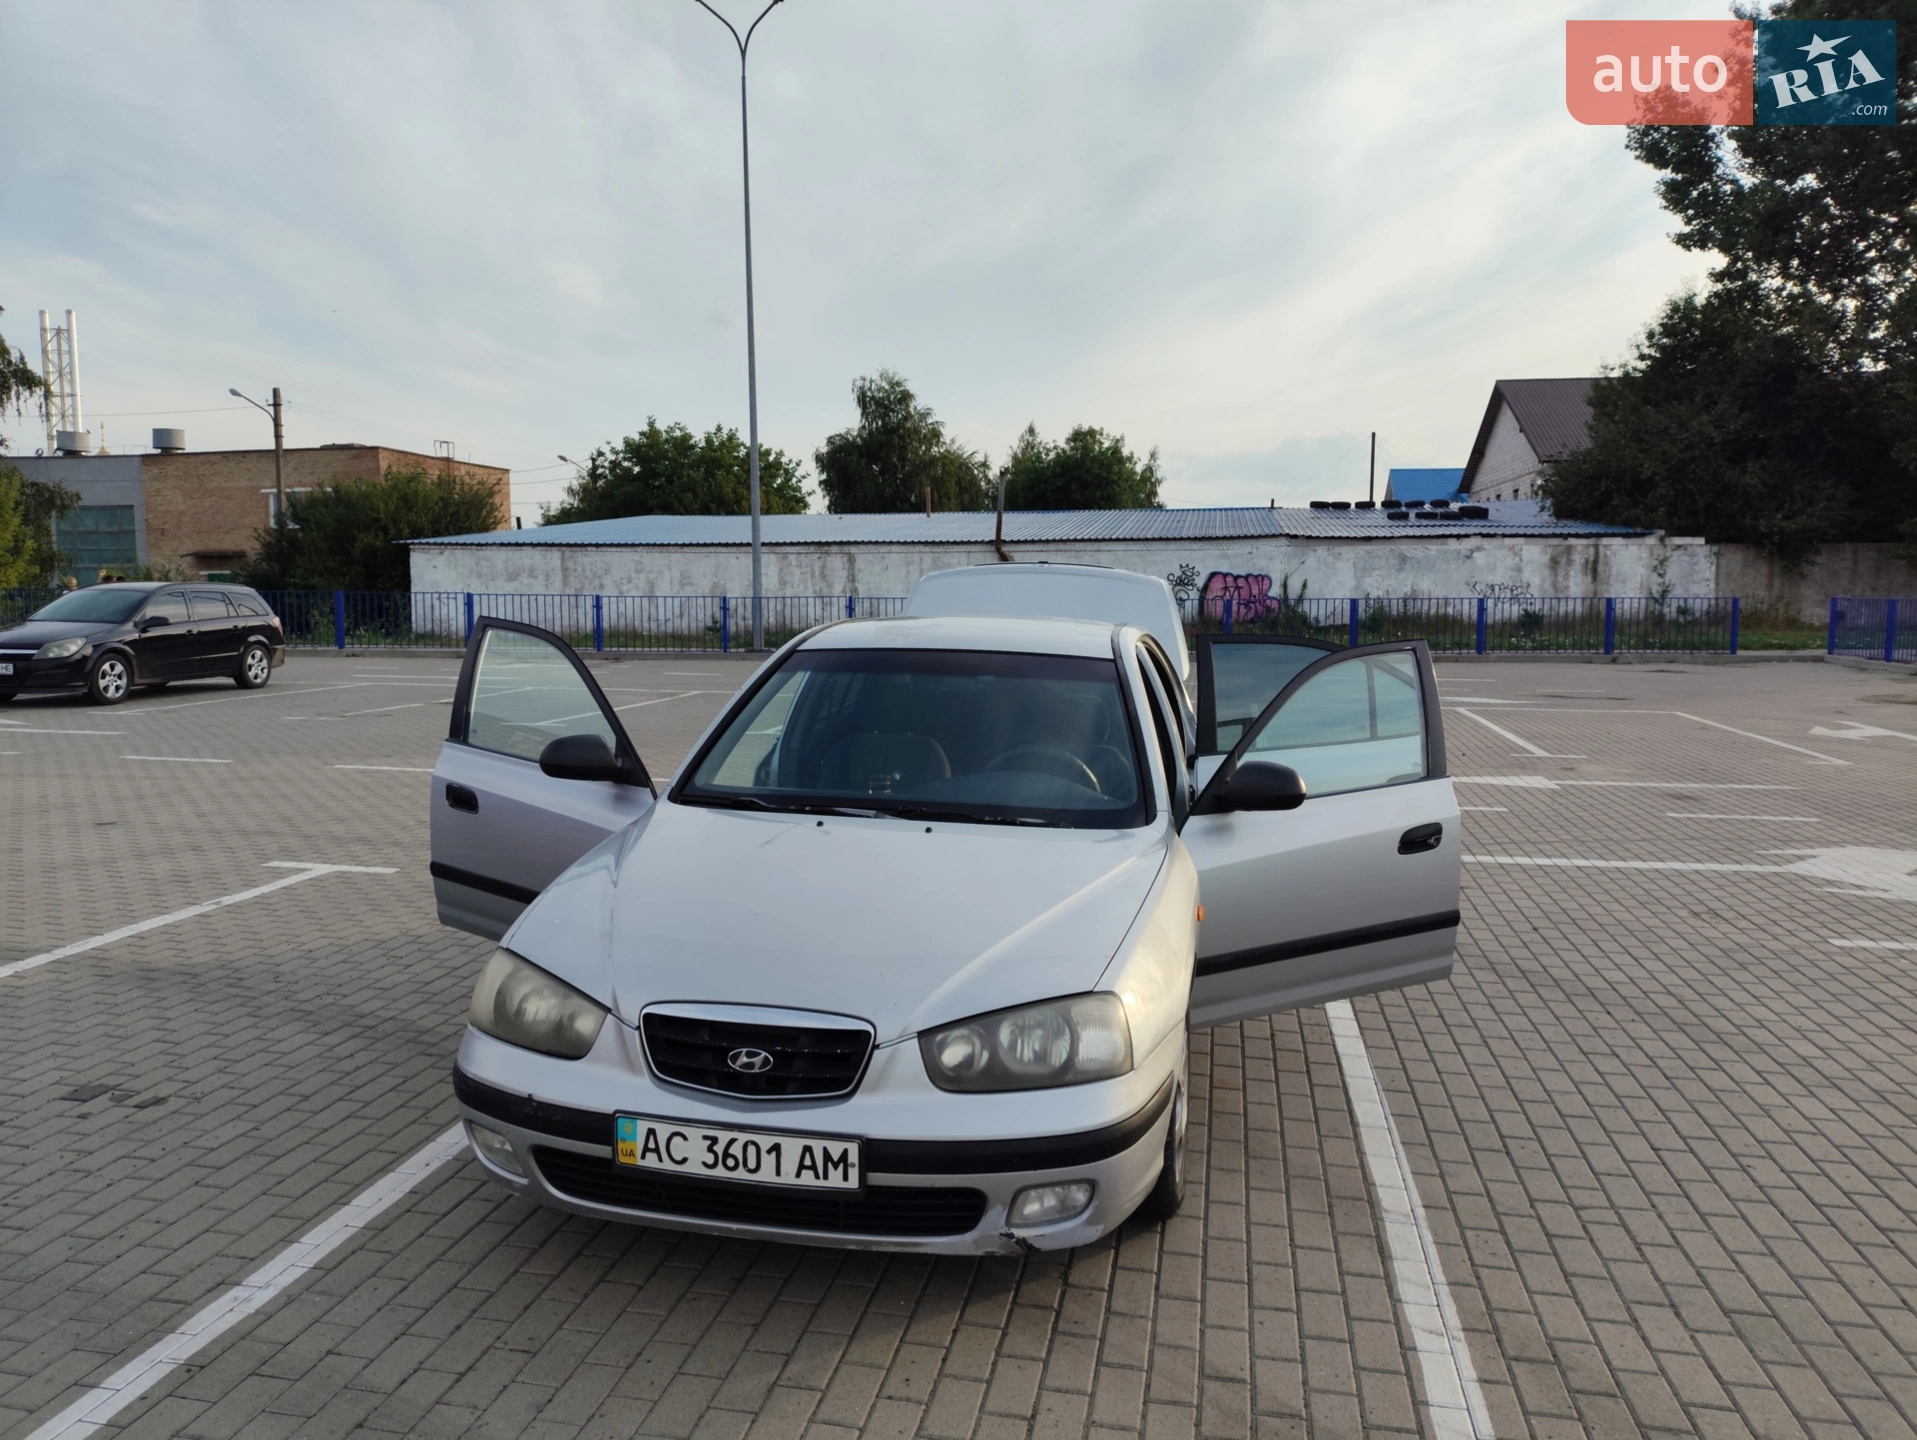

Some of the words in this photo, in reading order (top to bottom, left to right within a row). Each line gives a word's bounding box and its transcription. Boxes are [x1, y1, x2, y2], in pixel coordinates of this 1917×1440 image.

[620, 1147, 636, 1159] UA
[640, 1127, 689, 1166] AC
[701, 1134, 782, 1178] 3601
[795, 1144, 849, 1183] AM
